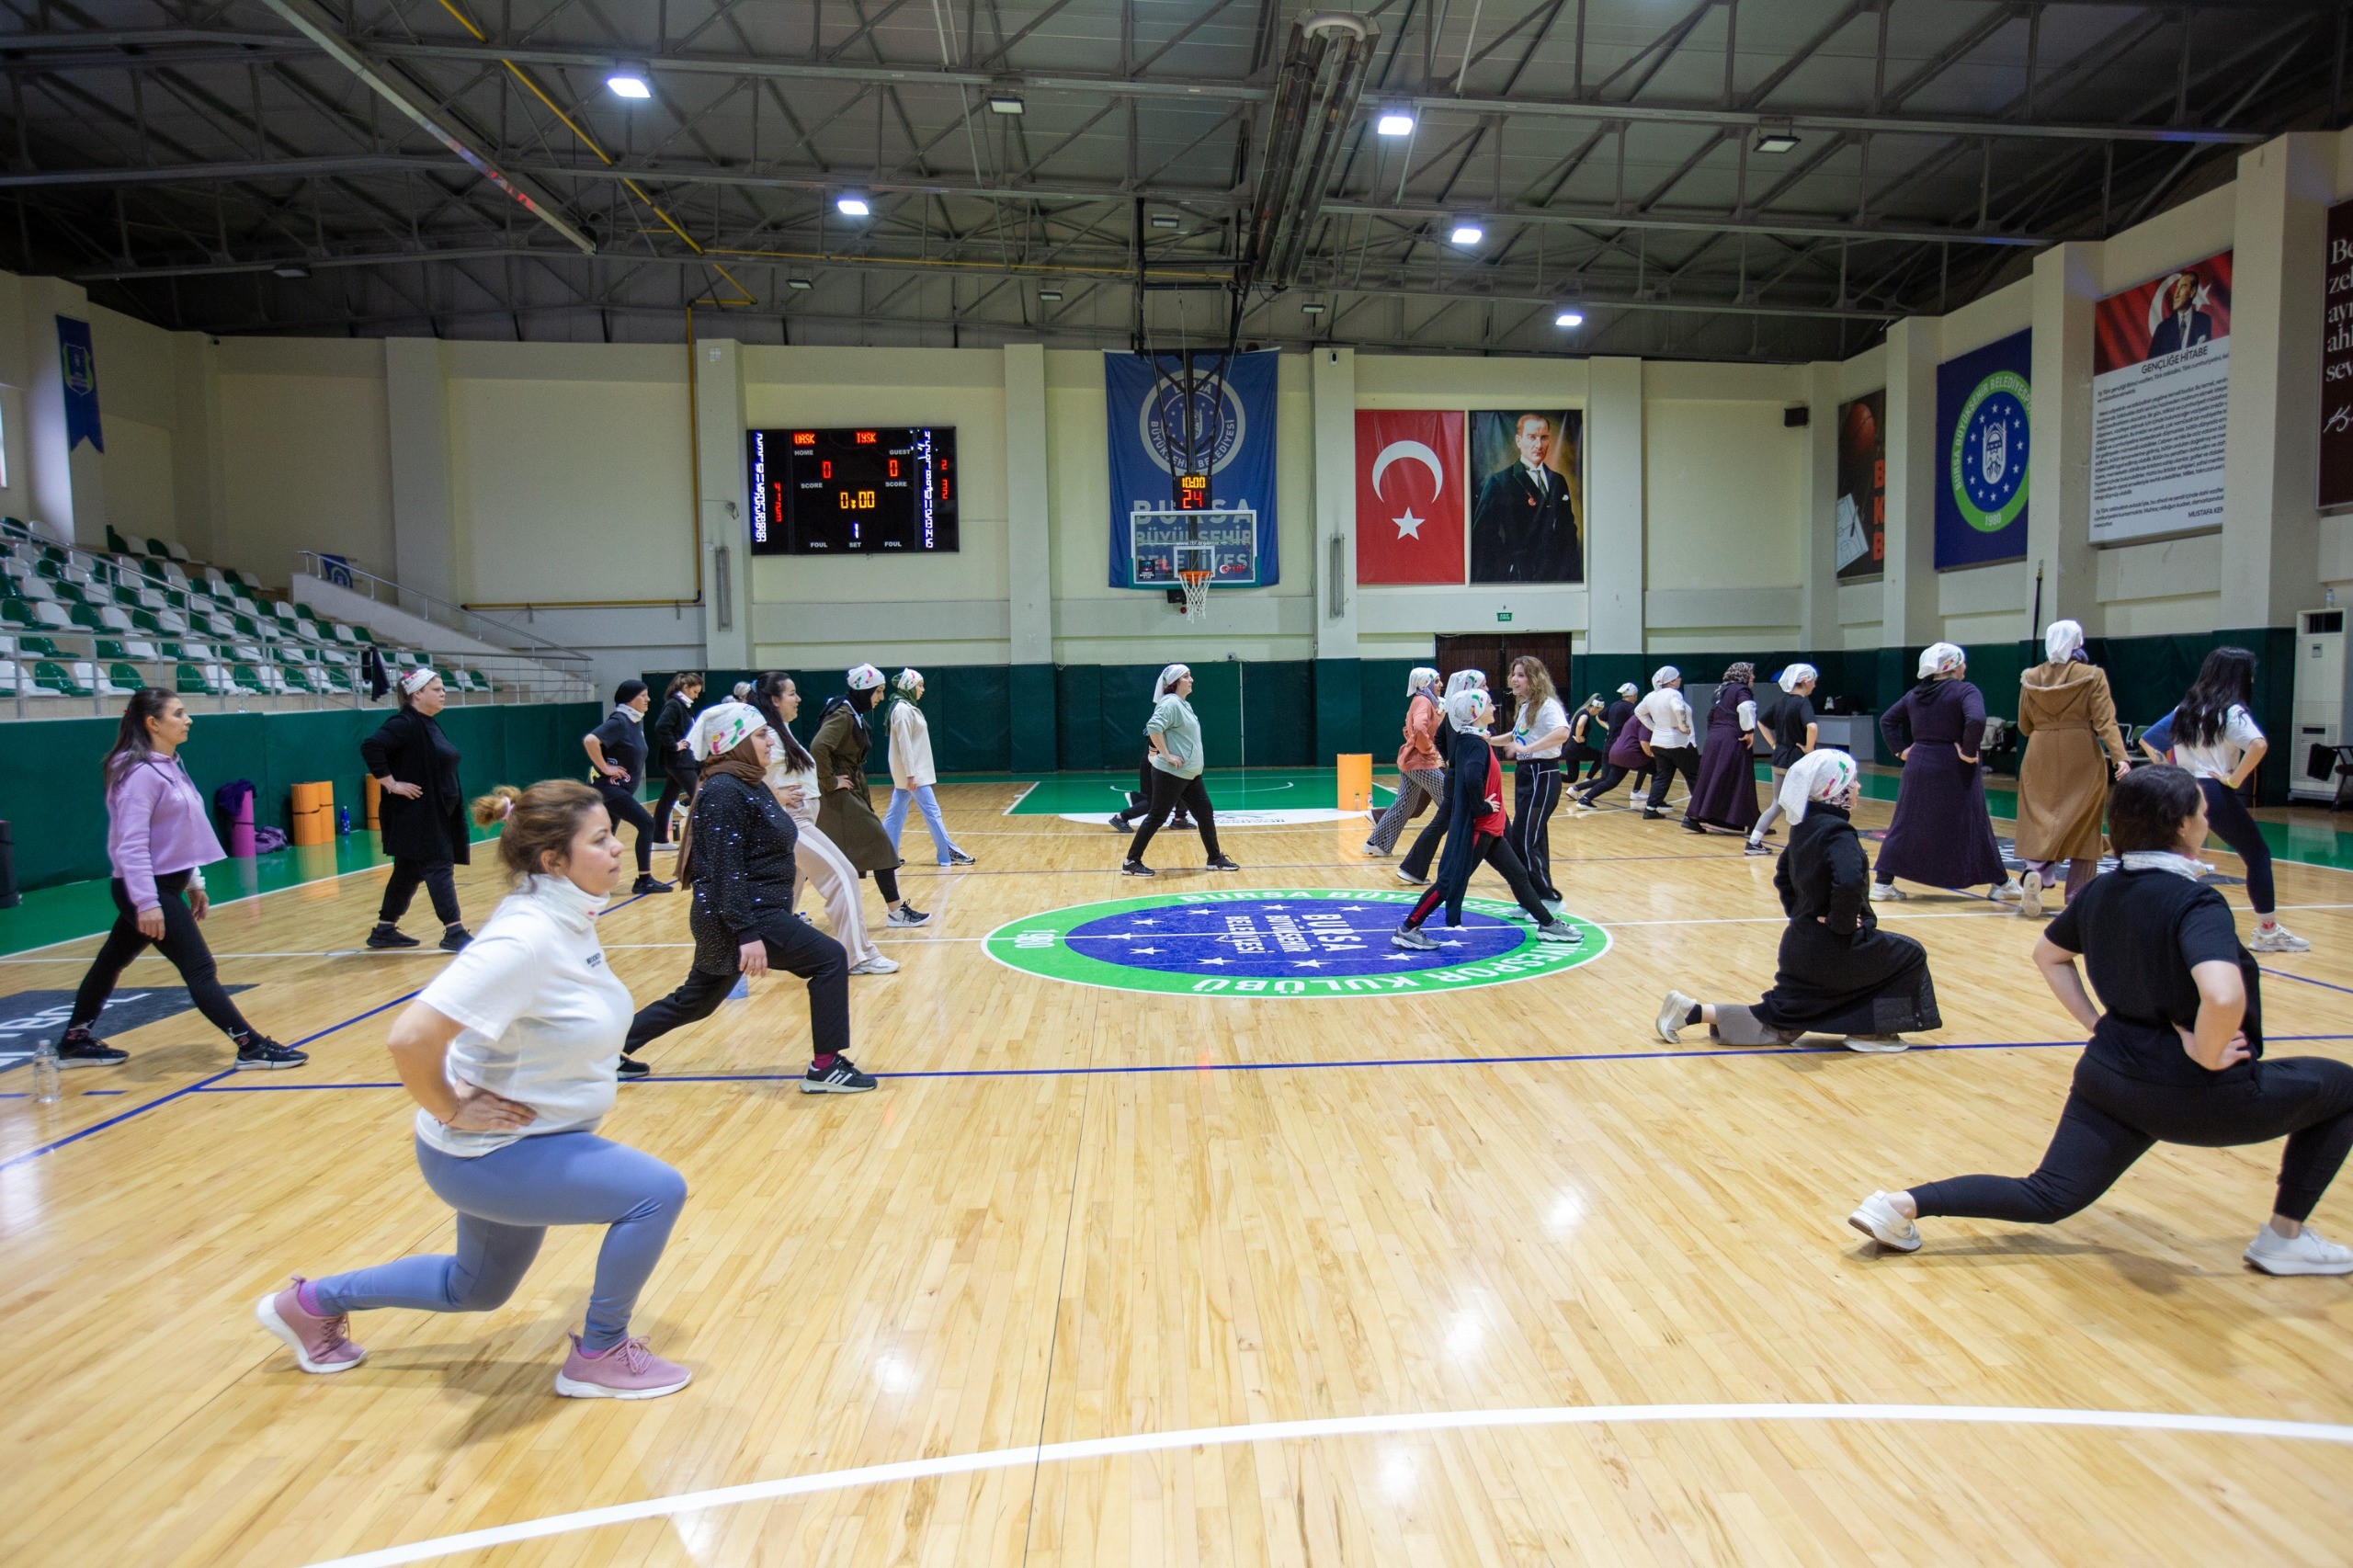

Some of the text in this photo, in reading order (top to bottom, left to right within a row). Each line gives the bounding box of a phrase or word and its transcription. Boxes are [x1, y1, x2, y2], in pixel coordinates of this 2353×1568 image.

[2142, 354, 2179, 375] GENÇLİĞE
[2180, 346, 2208, 363] HİTABE
[1990, 375, 2031, 414] BELEDİYESPO
[822, 460, 831, 479] 0
[889, 460, 898, 477] 0
[1182, 477, 1206, 488] 10:00
[840, 491, 875, 509] 0:00
[1182, 489, 1202, 508] 24
[1133, 498, 1252, 525] BUSA
[1984, 512, 2002, 527] 1980
[2188, 507, 2212, 517] MUSTAFA
[854, 523, 859, 539] 1
[1177, 891, 1313, 903] BURSA
[1014, 928, 1059, 949] 1980
[1302, 914, 1368, 952] BURSA
[1191, 975, 1421, 994] KULÜBÜ
